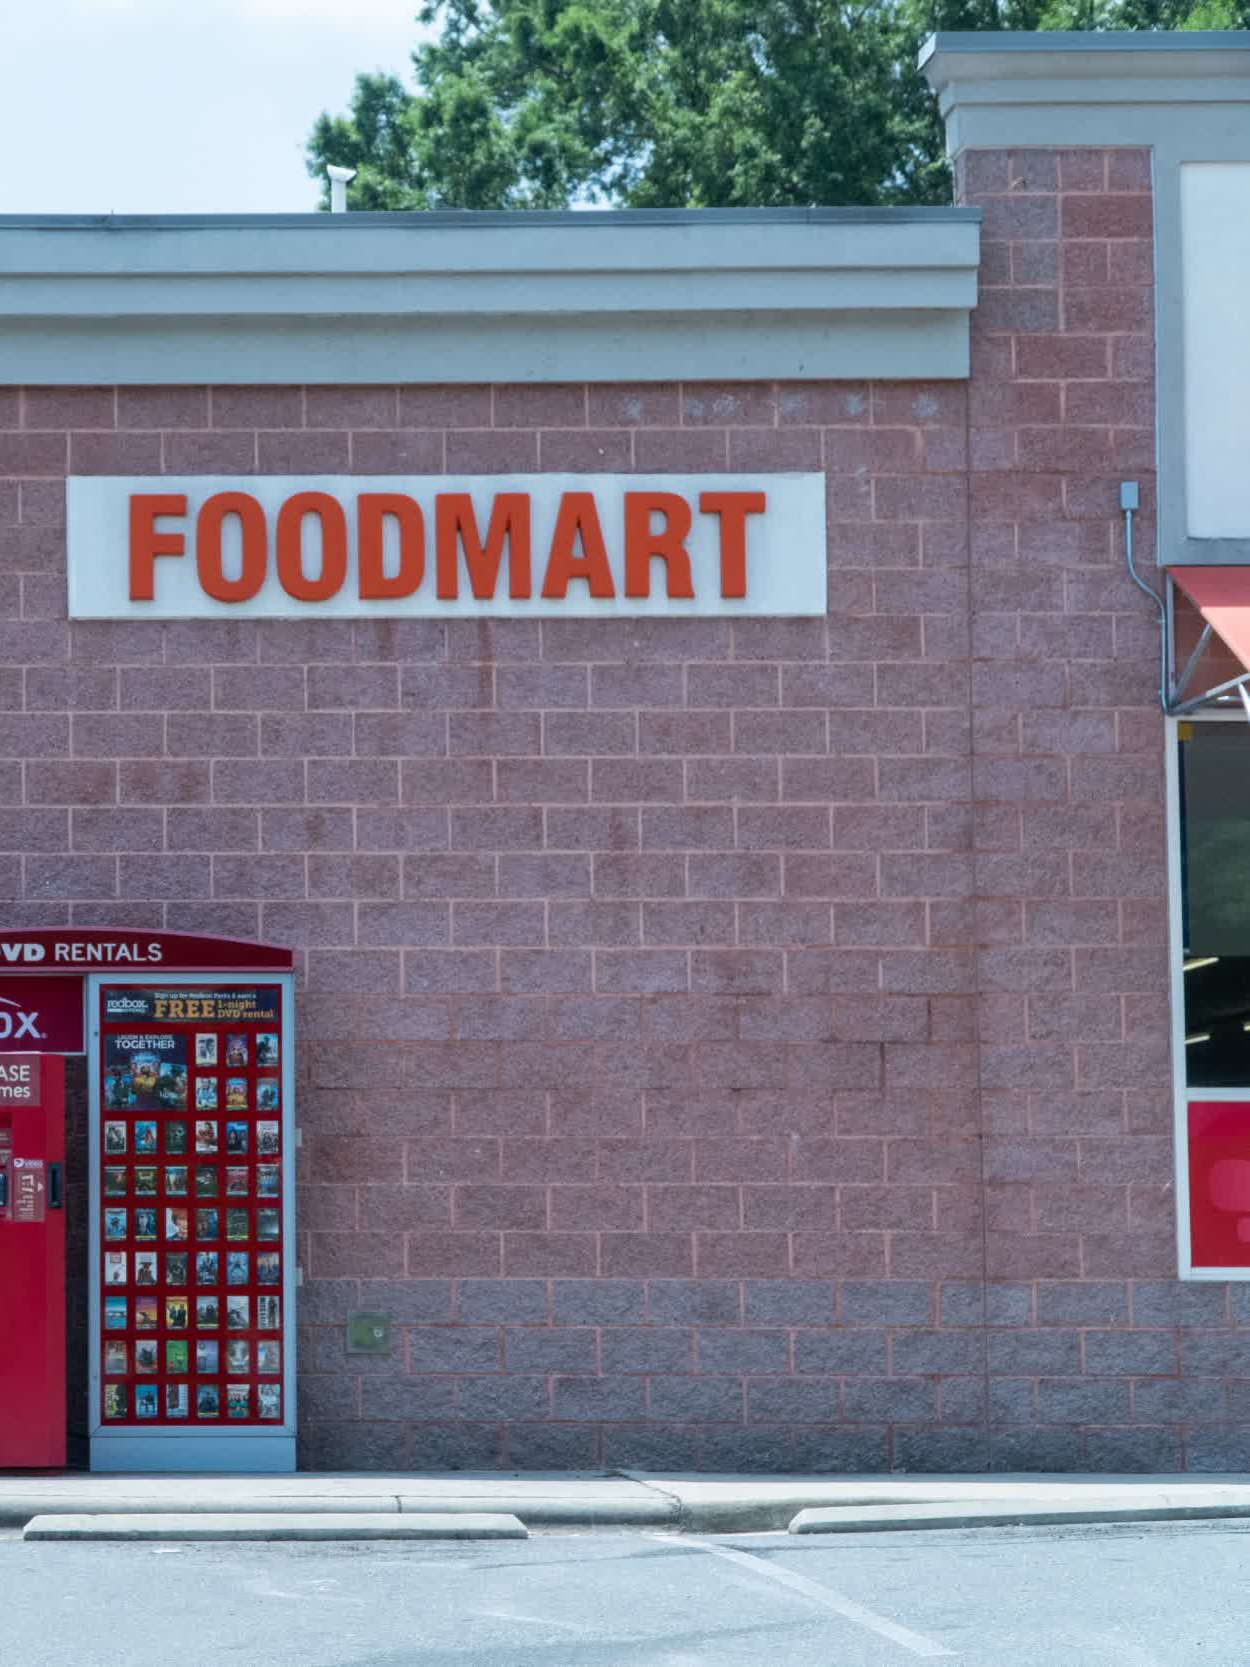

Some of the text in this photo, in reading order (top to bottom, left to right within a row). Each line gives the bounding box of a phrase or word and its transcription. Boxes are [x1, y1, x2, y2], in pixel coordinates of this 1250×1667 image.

[128, 490, 767, 604] FOODMART
[54, 943, 163, 962] RENTALS
[154, 1000, 215, 1018] FREE
[218, 999, 256, 1010] 1-night
[218, 1009, 274, 1018] DVD rental
[115, 1040, 175, 1049] TOGETHER
